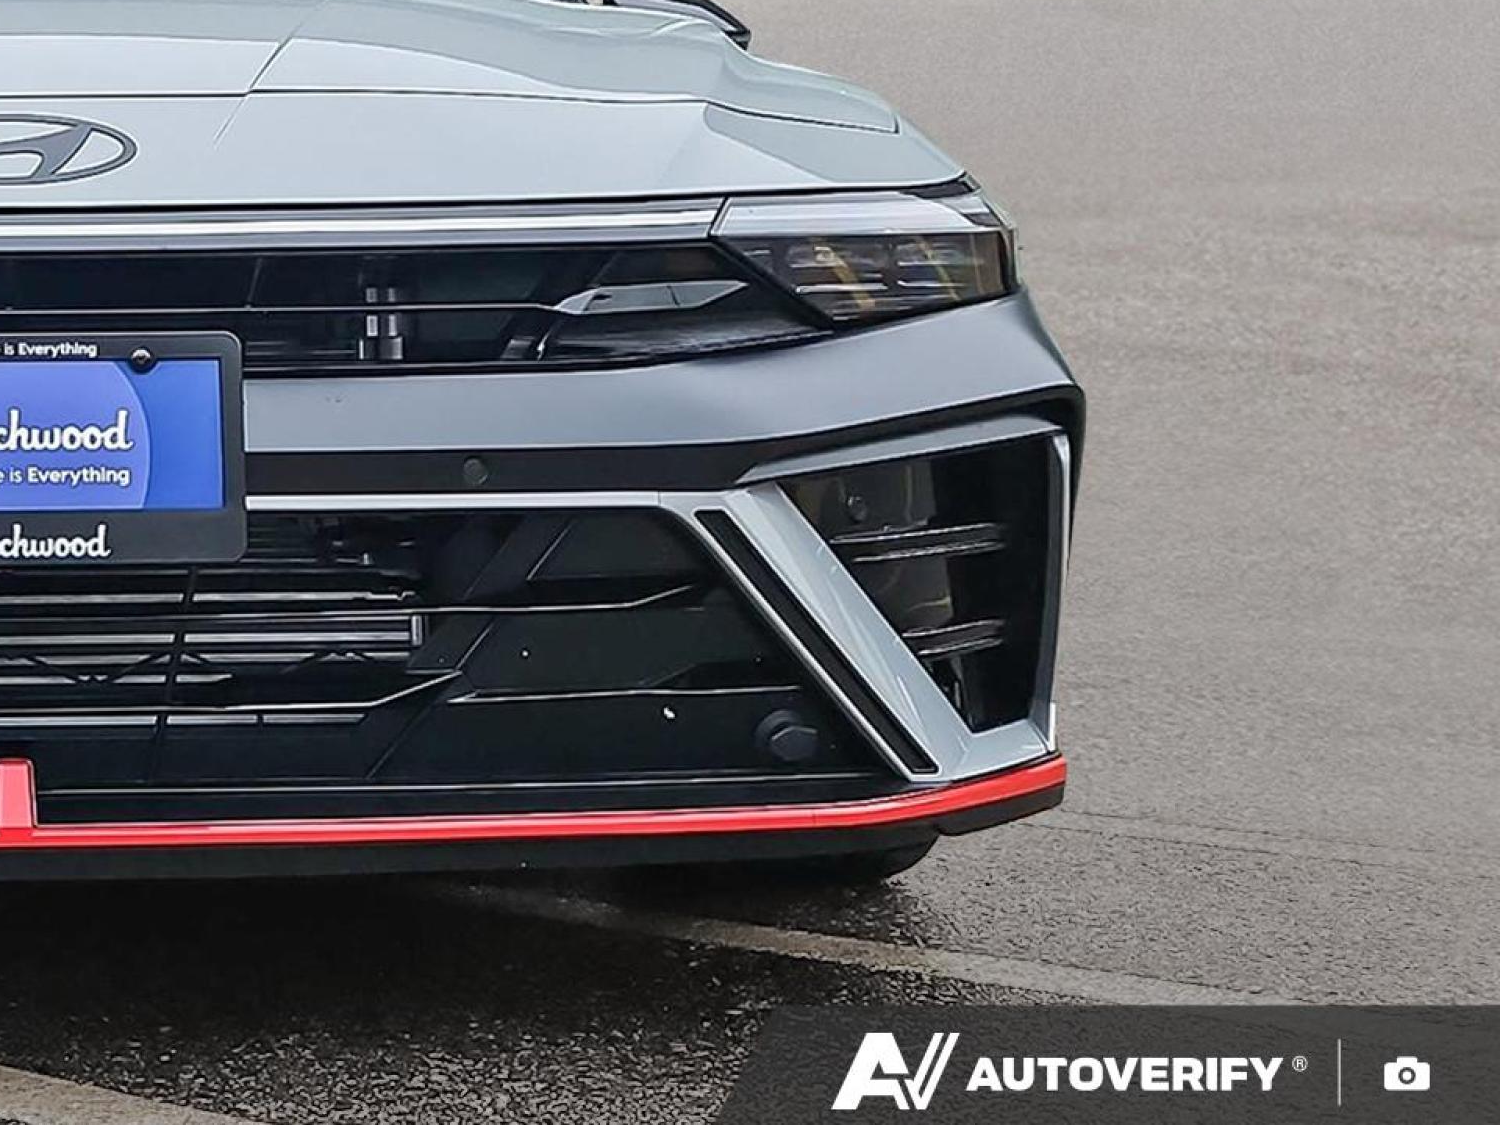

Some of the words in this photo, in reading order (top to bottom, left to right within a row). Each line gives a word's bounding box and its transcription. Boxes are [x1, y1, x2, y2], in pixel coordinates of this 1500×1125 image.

[4, 342, 15, 356] is
[18, 341, 98, 359] Everything
[9, 466, 23, 485] is
[27, 466, 131, 487] Everything
